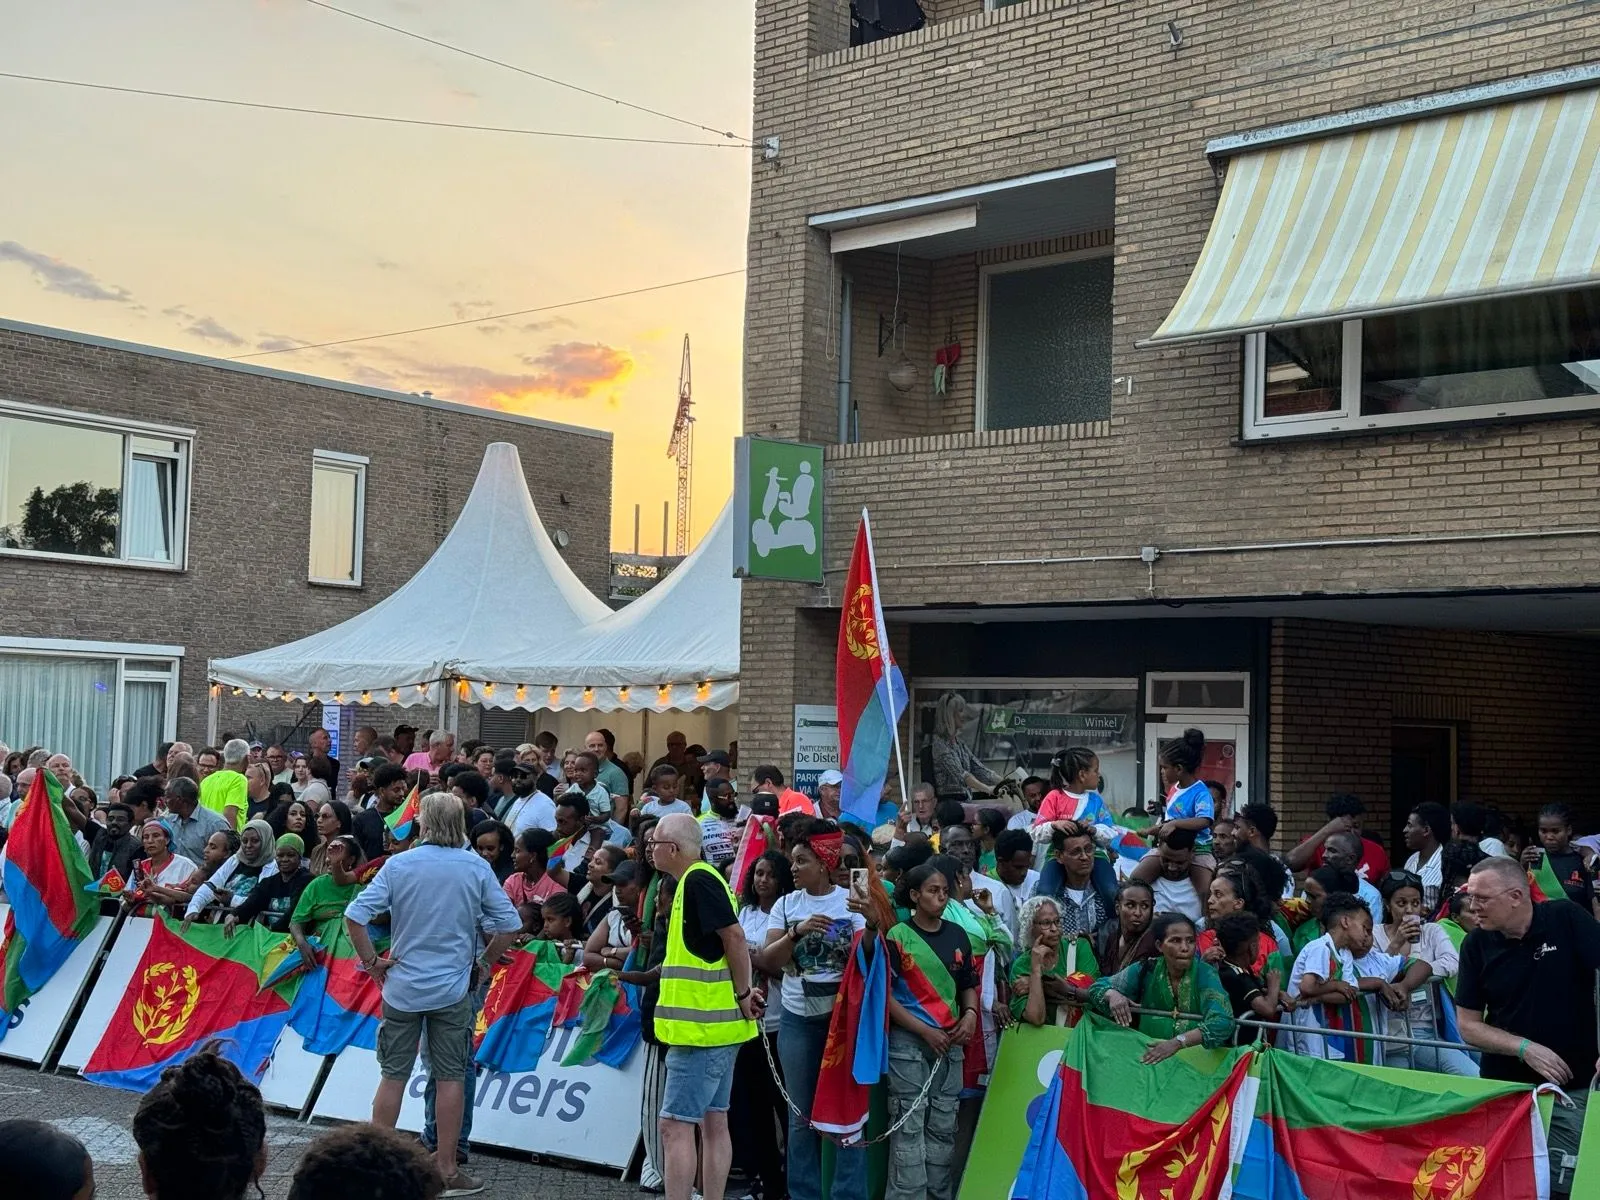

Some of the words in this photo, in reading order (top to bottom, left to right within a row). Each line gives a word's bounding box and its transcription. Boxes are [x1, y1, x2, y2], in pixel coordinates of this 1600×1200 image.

[1013, 716, 1026, 726] De
[1084, 717, 1117, 728] Winkel
[797, 752, 810, 763] De
[813, 752, 839, 763] Distel
[799, 785, 812, 795] VIA
